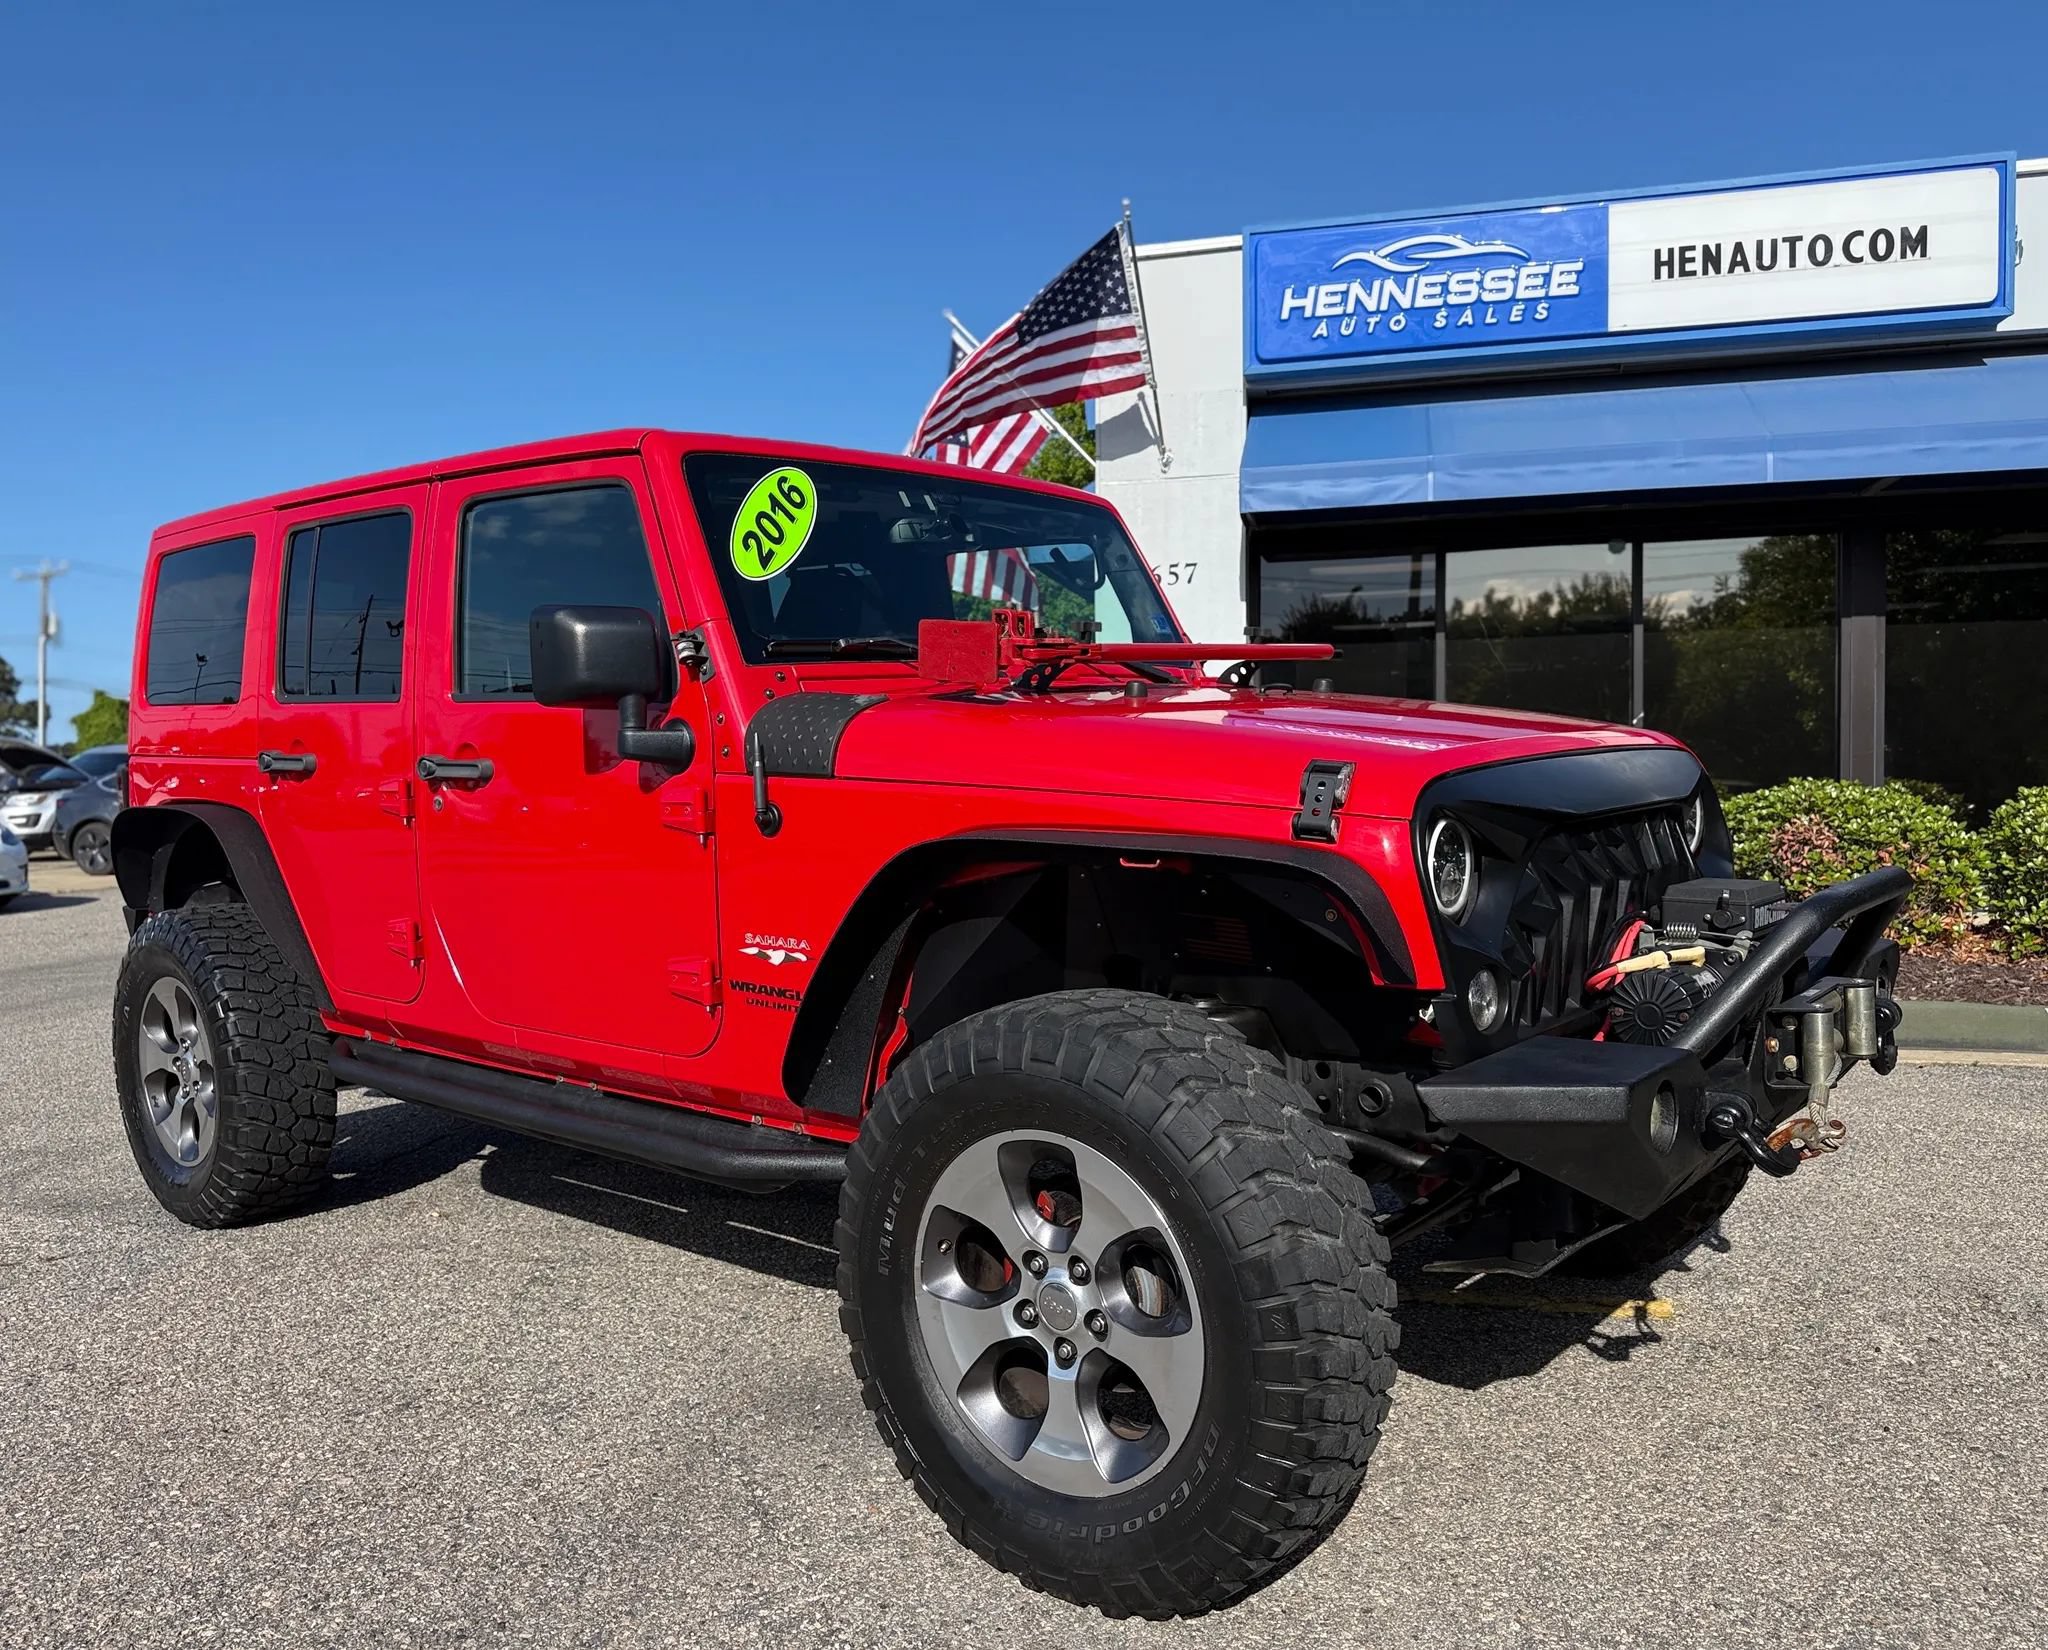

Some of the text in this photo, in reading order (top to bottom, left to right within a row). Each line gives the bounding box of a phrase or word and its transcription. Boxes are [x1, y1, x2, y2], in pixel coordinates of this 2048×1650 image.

[1280, 258, 1584, 320] HENNESSEE
[1311, 301, 1550, 339] AUTO SALES
[741, 475, 807, 572] 2016
[744, 932, 811, 951] SAHARA
